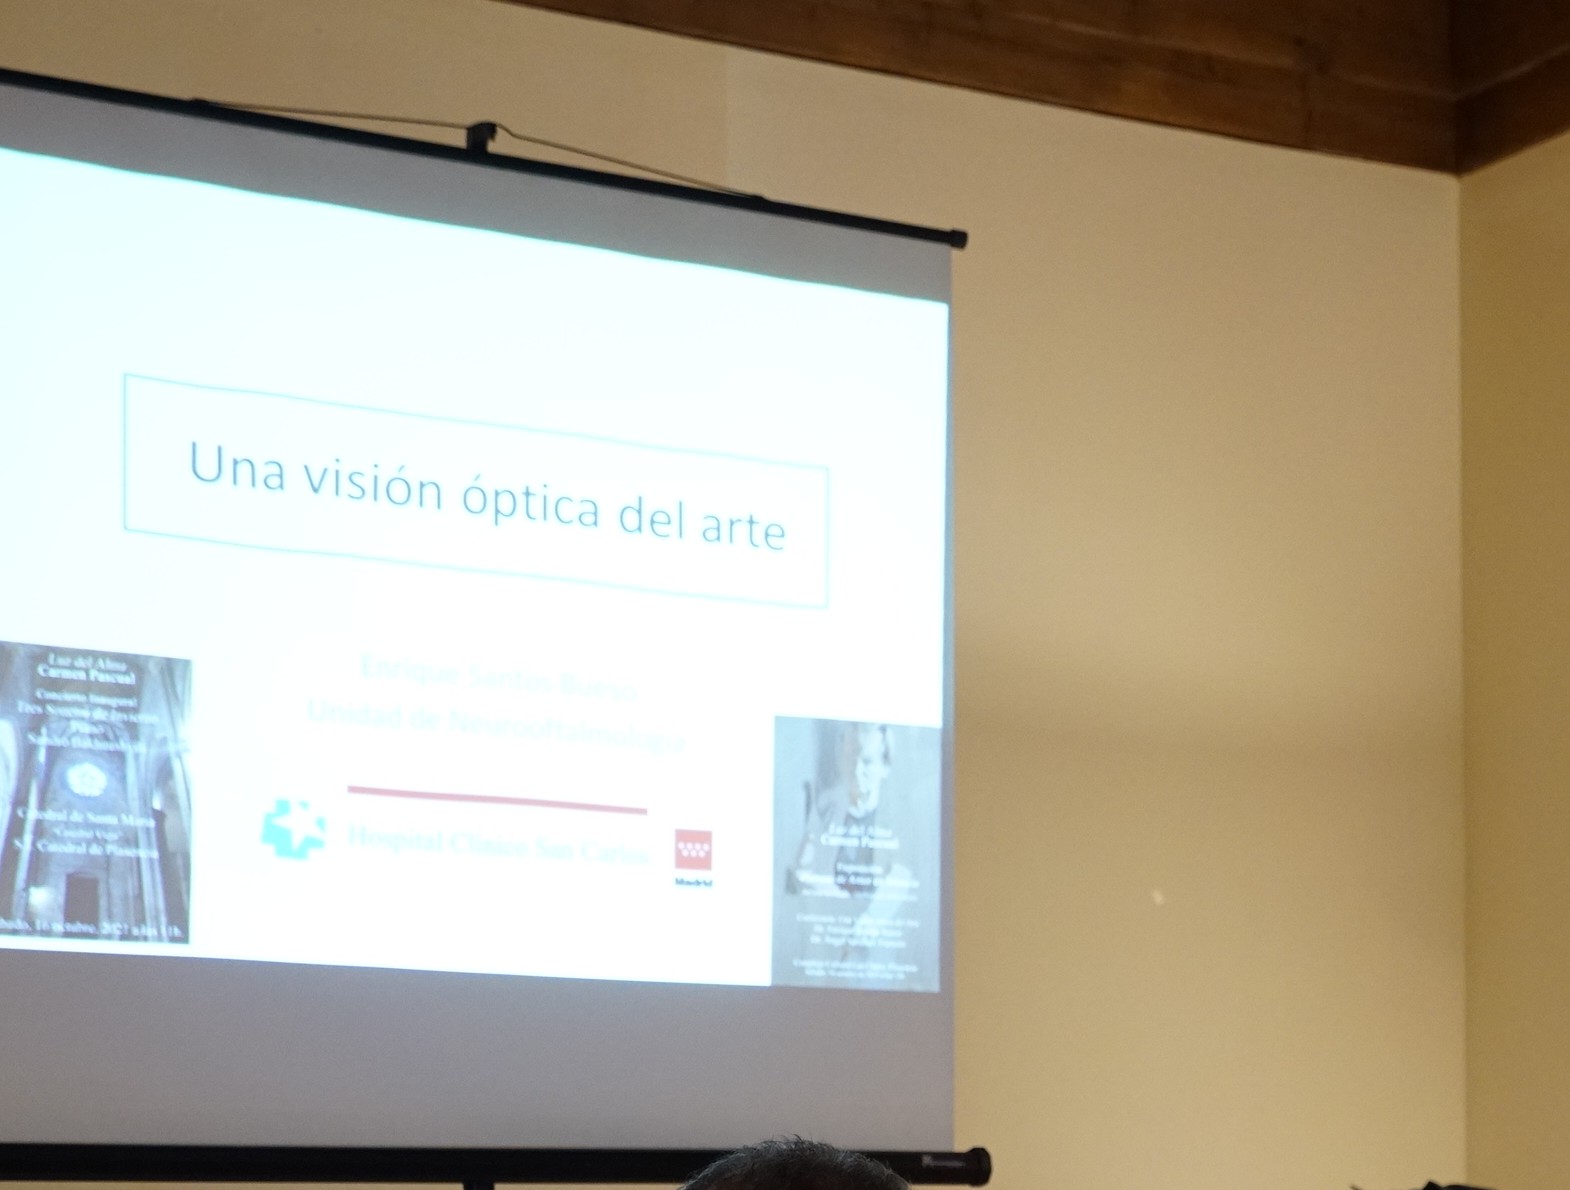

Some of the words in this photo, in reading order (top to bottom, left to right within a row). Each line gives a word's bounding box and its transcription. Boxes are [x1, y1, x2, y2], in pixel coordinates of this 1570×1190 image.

[191, 441, 285, 492] Una
[304, 457, 443, 510] visión
[463, 474, 600, 527] óptica
[620, 496, 684, 540] del
[702, 513, 787, 552] arte
[359, 652, 461, 687] Enrique
[468, 663, 554, 694] Santos
[560, 671, 640, 703] Bueso
[306, 697, 403, 730] Unidad
[410, 704, 442, 732] de
[348, 823, 443, 855] Hospital
